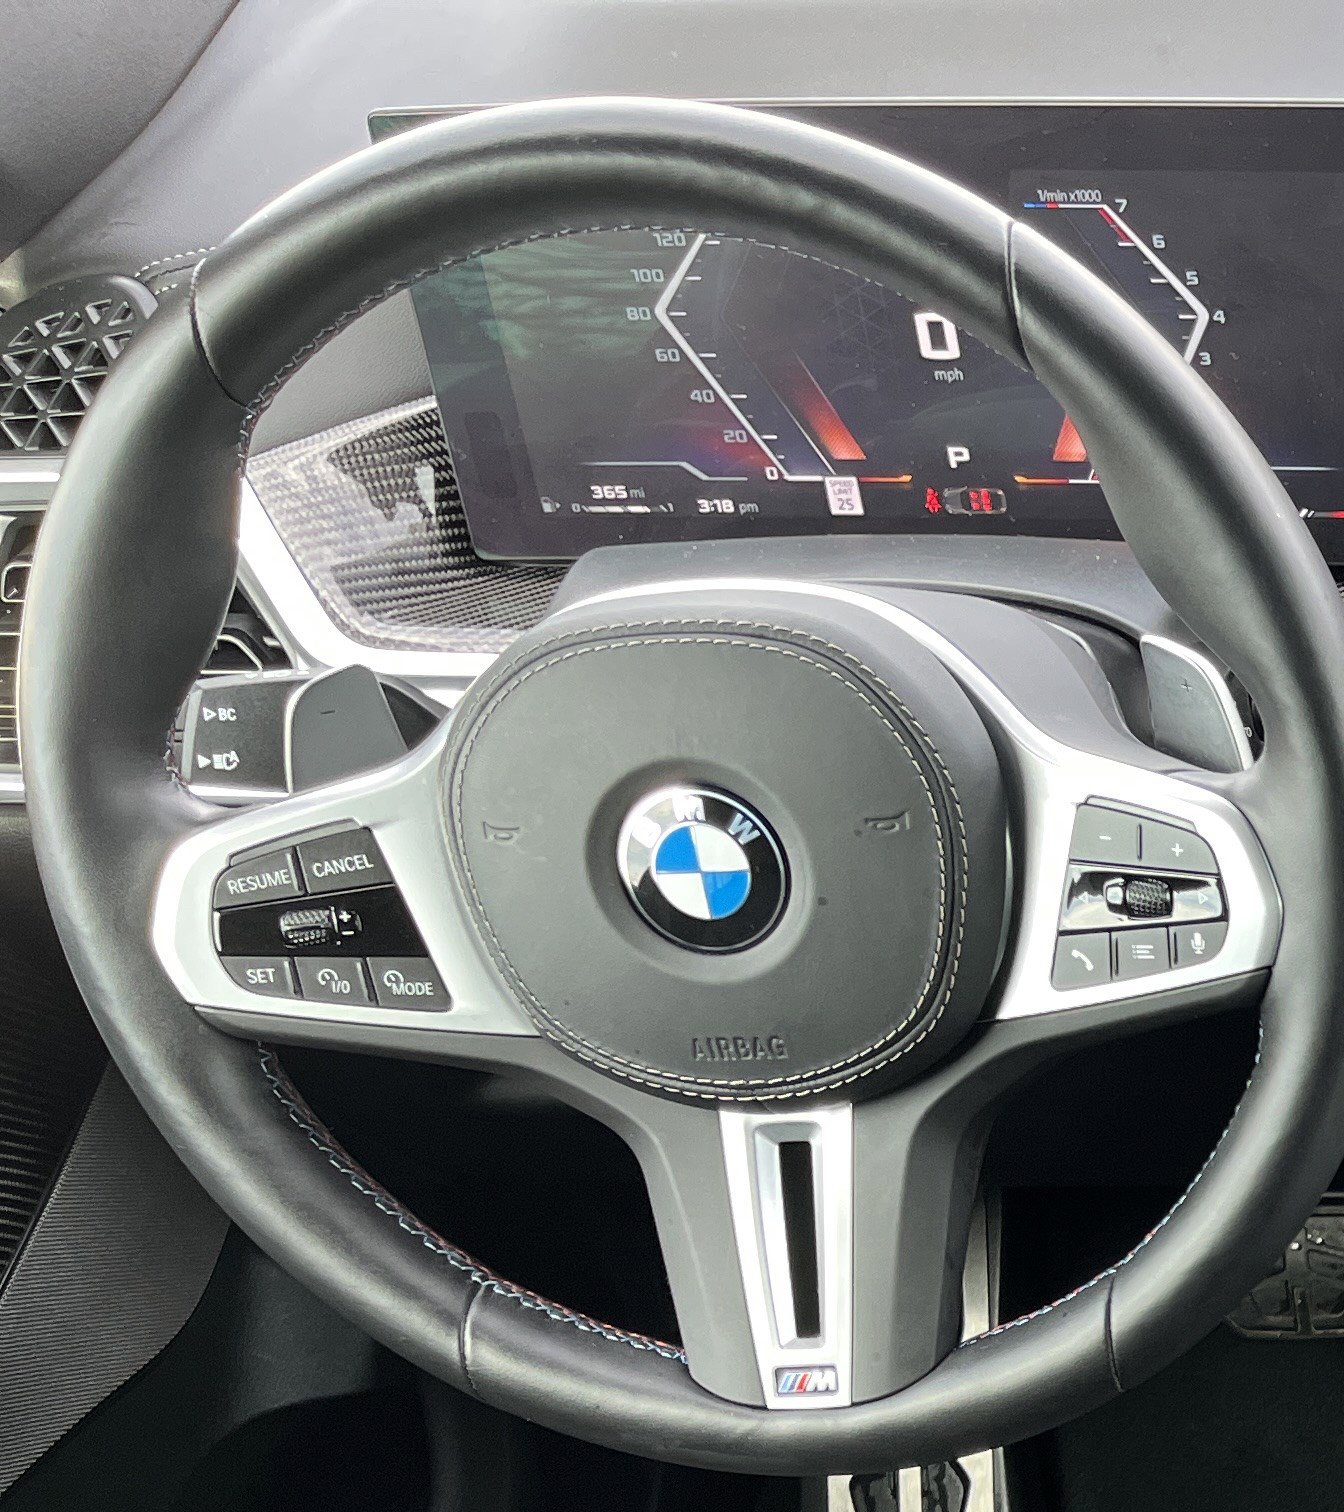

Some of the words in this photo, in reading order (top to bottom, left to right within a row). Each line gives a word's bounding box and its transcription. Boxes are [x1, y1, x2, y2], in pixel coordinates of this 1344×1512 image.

[1069, 189, 1102, 203] x1000
[1115, 199, 1128, 213] 7
[653, 232, 686, 247] 120
[1152, 234, 1166, 249] 6
[630, 268, 664, 283] 100
[1185, 271, 1199, 286] 5
[625, 307, 651, 321] 80
[1212, 310, 1226, 324] 4
[914, 312, 961, 361] 0
[655, 348, 680, 362] 60
[1198, 352, 1211, 366] 3
[934, 368, 964, 384] mph
[690, 389, 715, 403] 40
[723, 429, 748, 443] 20
[947, 446, 970, 469] P
[764, 466, 779, 480] 0
[590, 485, 628, 499] 365
[629, 487, 646, 499] mi
[697, 499, 735, 514] 3:18
[738, 502, 760, 516] pm
[837, 498, 855, 511] 25
[218, 707, 237, 721] BC
[630, 795, 761, 848] BMW
[312, 854, 374, 878] CANCEL
[227, 869, 291, 895] RESUME
[246, 968, 276, 984] SET
[392, 981, 434, 996] MODE
[691, 1036, 788, 1061] AIRBAG
